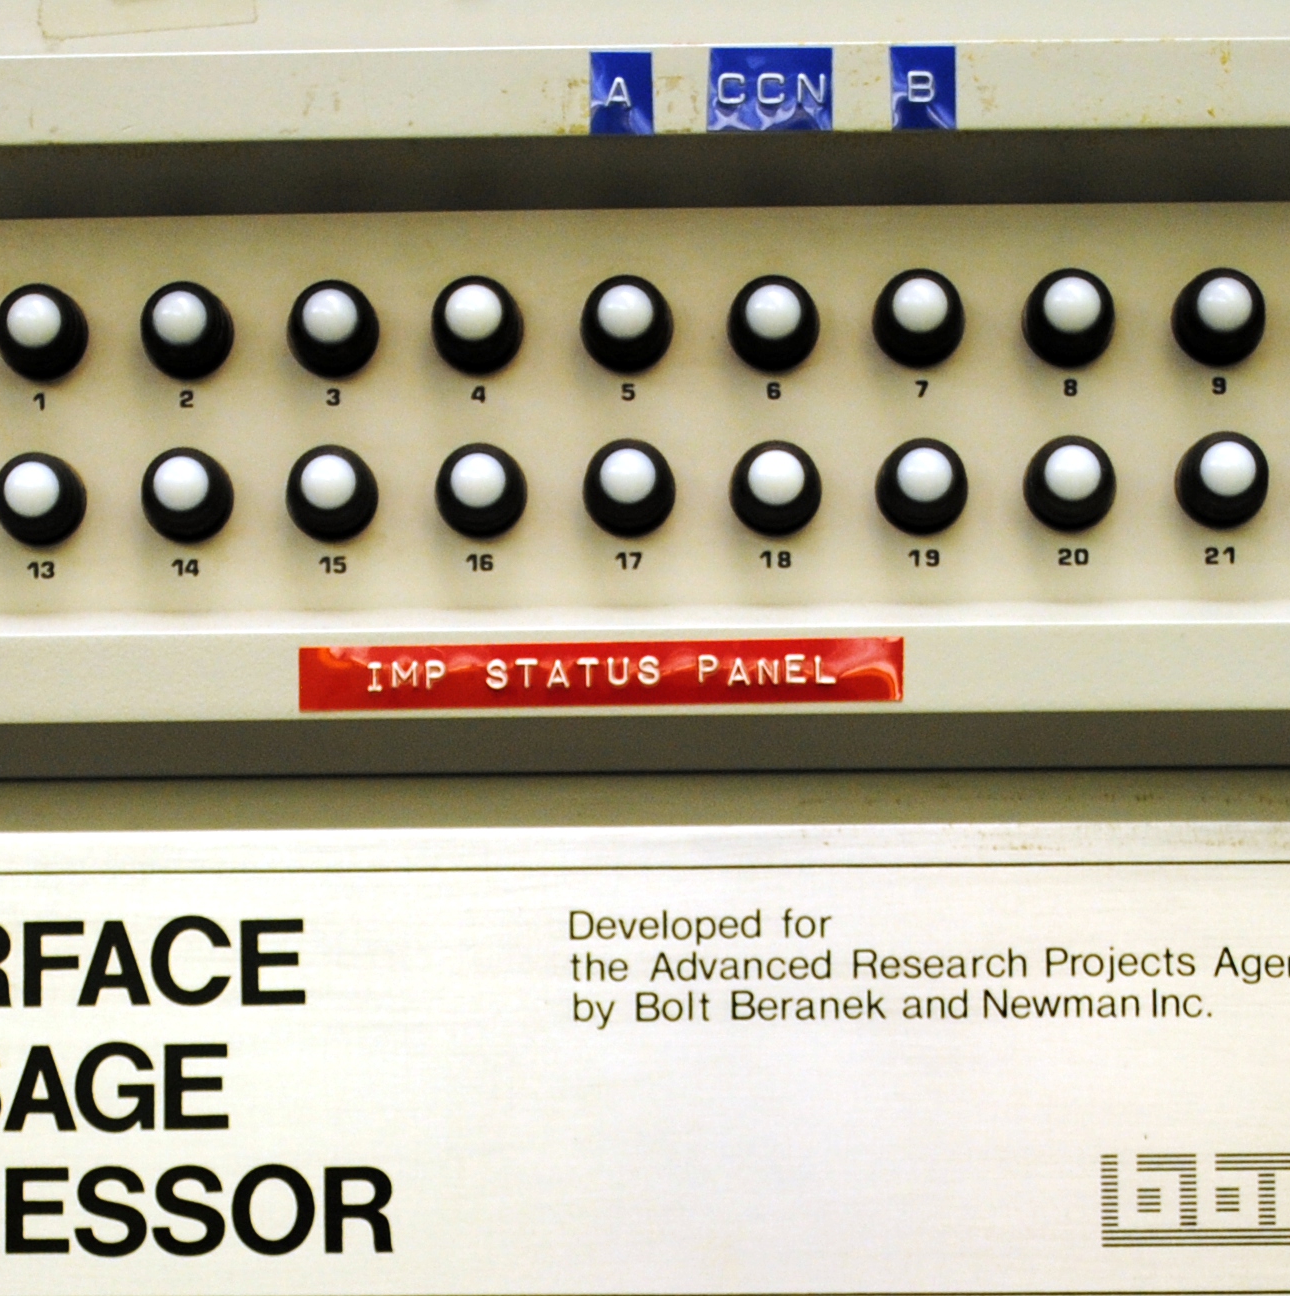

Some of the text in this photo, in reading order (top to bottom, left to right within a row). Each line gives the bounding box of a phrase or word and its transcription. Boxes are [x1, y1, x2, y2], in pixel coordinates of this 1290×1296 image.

[605, 76, 632, 108] A
[717, 72, 826, 105] CCN
[907, 70, 935, 103] B
[471, 385, 486, 403] 4
[621, 384, 636, 401] 5
[767, 382, 781, 400] 6
[915, 379, 929, 398] 7
[1063, 376, 1078, 397] 8
[1211, 377, 1226, 395] 9
[33, 392, 45, 410] 1
[179, 390, 194, 408] 2
[326, 388, 341, 406] 3
[319, 555, 347, 574] 15
[466, 553, 493, 571] 16
[615, 551, 642, 570] 17
[760, 550, 791, 568] 18
[908, 549, 940, 567] 19
[1058, 548, 1089, 566] 20
[1204, 546, 1235, 565] 21
[27, 560, 55, 579] 13
[171, 558, 199, 576] 14
[367, 652, 837, 692] IMP STATUS PANEL
[569, 908, 832, 946] Developed for
[570, 952, 628, 982] the
[650, 949, 831, 981] Advanced
[853, 948, 1027, 979] Research
[1046, 947, 1196, 983] Projects
[573, 988, 1212, 1030] by Bolt Beranek and Newman Inc.
